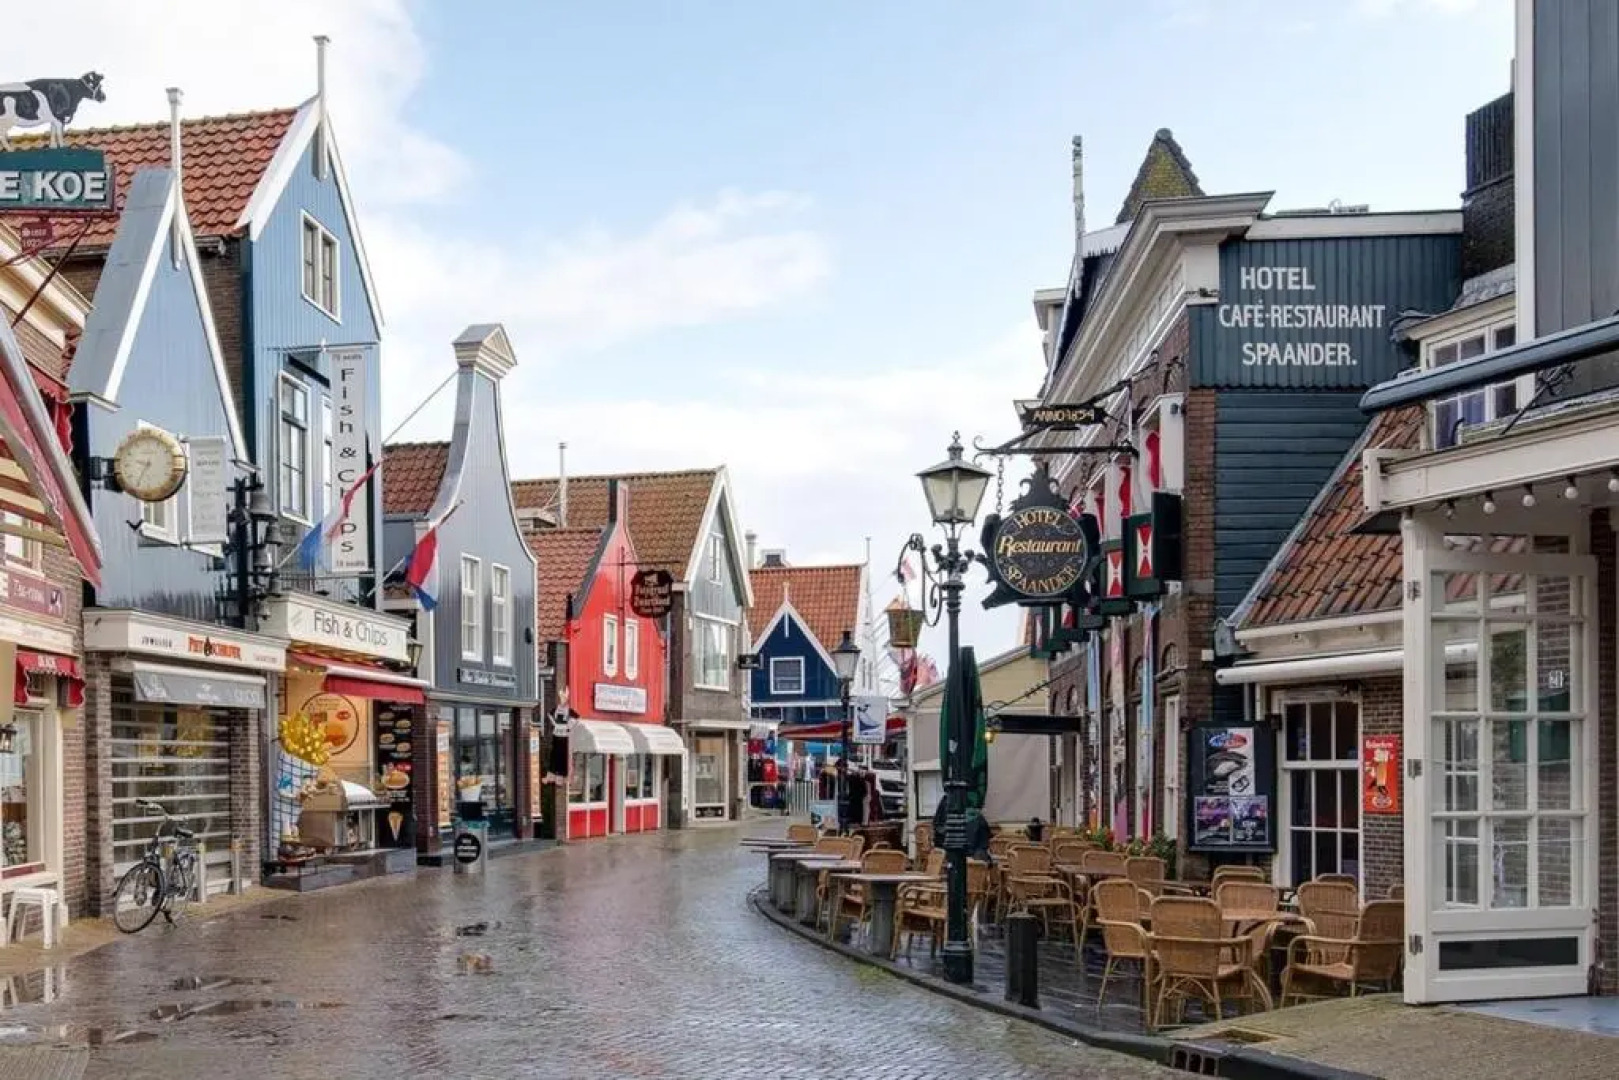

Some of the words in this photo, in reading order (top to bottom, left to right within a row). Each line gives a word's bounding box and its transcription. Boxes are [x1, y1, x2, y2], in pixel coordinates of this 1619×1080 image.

[34, 171, 105, 202] KOE
[1240, 266, 1316, 291] HOTEL
[1242, 342, 1358, 366] SPAANDER.
[339, 447, 357, 459] &
[1017, 510, 1061, 529] HOTEL
[998, 535, 1082, 557] Restaurant
[1005, 565, 1075, 592] SPAANDER
[314, 610, 339, 635] Fish
[343, 621, 353, 639] &
[356, 620, 388, 646] Chips
